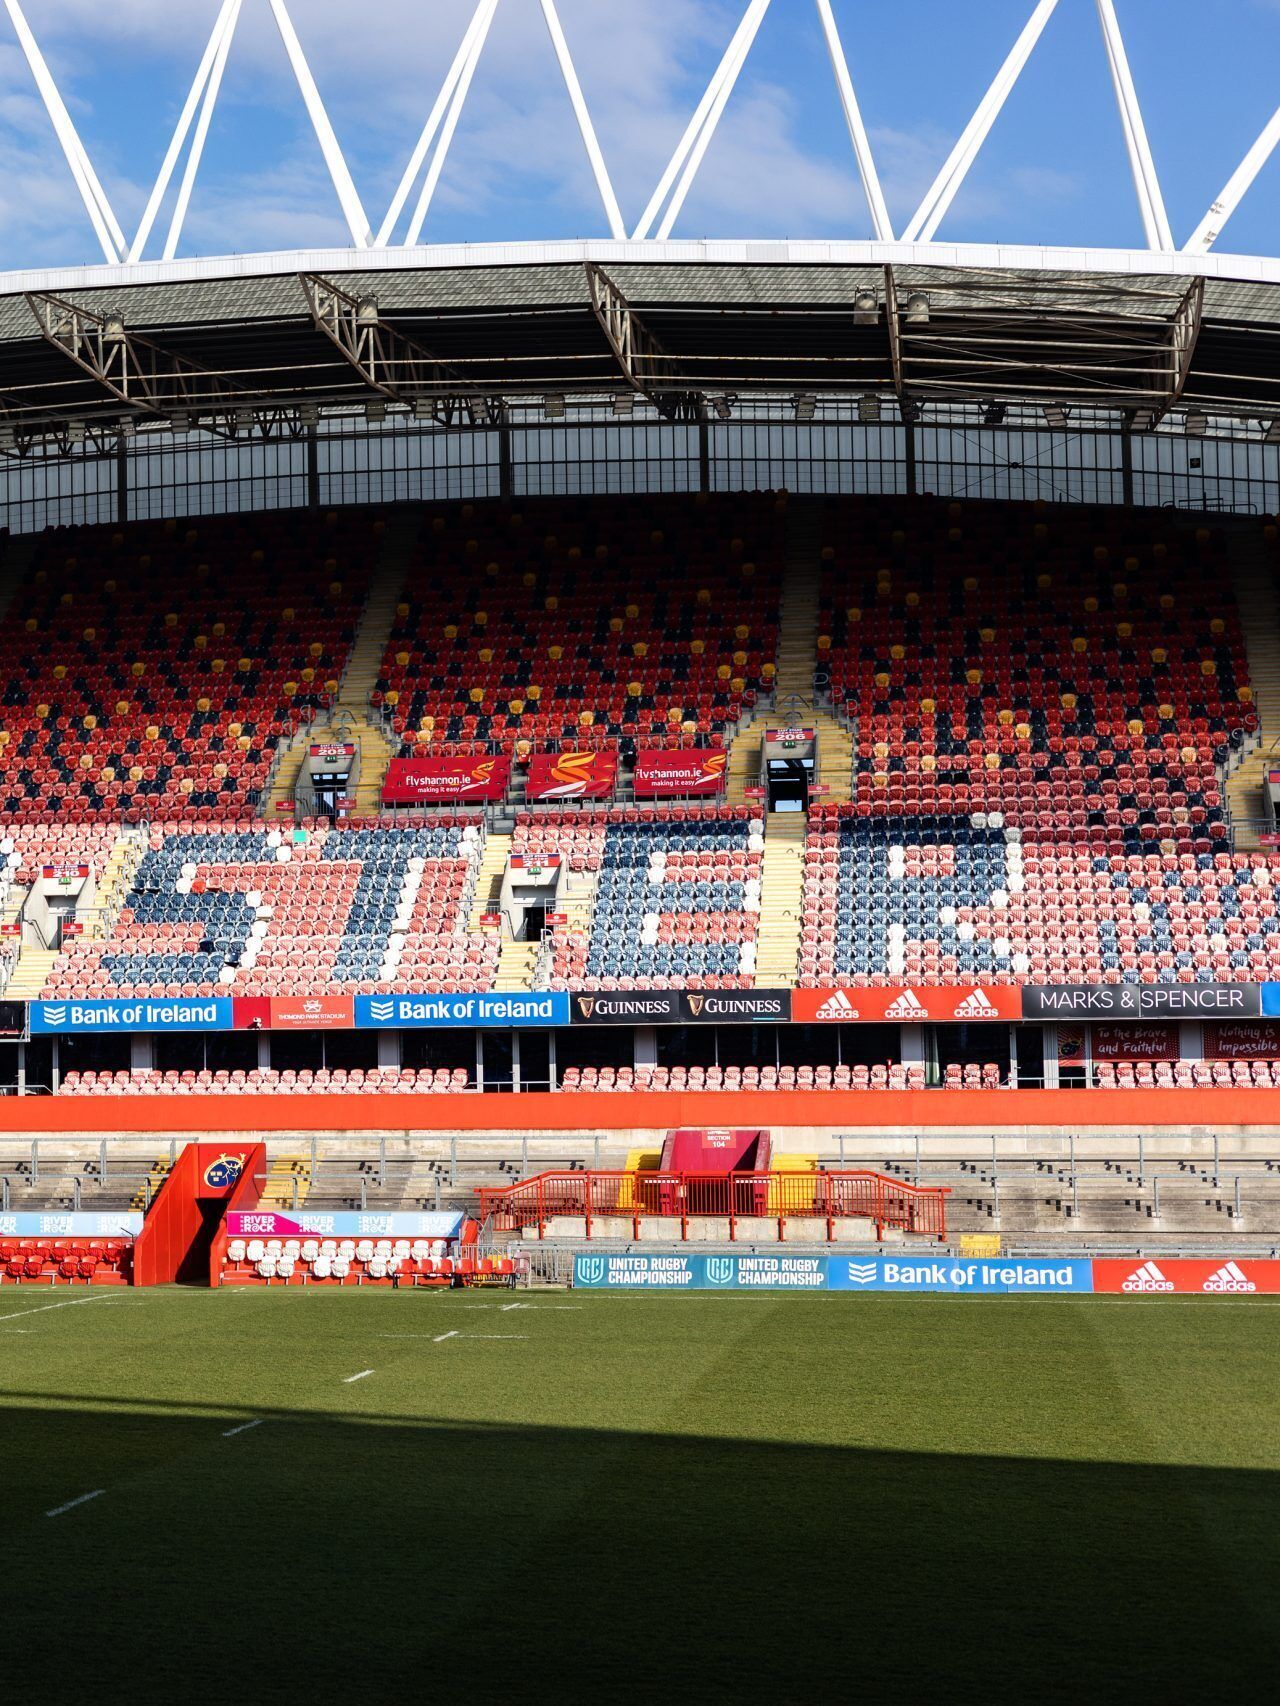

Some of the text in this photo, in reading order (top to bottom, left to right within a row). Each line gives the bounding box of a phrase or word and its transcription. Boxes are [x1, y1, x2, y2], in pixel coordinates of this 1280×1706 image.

[406, 774, 470, 786] flyshannon.ie
[704, 998, 781, 1014] GUINNESS
[1040, 989, 1244, 1009] MARKS & SPENCER
[71, 1004, 216, 1024] Bank of Ireland
[400, 999, 552, 1019] Bank of Ireland
[595, 1000, 670, 1014] GUINNESS
[816, 1006, 860, 1020] adidas
[884, 1005, 928, 1018] adidas
[954, 1004, 998, 1018] adidas
[1098, 1027, 1167, 1040] To the Brave
[1220, 1024, 1276, 1040] Nothing is
[1098, 1038, 1166, 1054] and Faithful
[1219, 1040, 1278, 1056] Impossible
[43, 1216, 73, 1224] RIVER
[100, 1216, 130, 1224] RIVER
[244, 1216, 275, 1224] RIVER
[302, 1216, 334, 1224] RIVER
[362, 1216, 393, 1224] RIVER
[244, 1224, 275, 1232] ROCK
[608, 1258, 688, 1271] UNITED RUGBY
[738, 1258, 819, 1272] UNITED RUGBY
[608, 1271, 692, 1284] CHAMPIONSHIP
[738, 1272, 824, 1286] CHAMPIONSHIP
[884, 1262, 1072, 1286] Bank of Ireland
[1122, 1278, 1175, 1292] adidas
[1203, 1278, 1256, 1292] adidas
